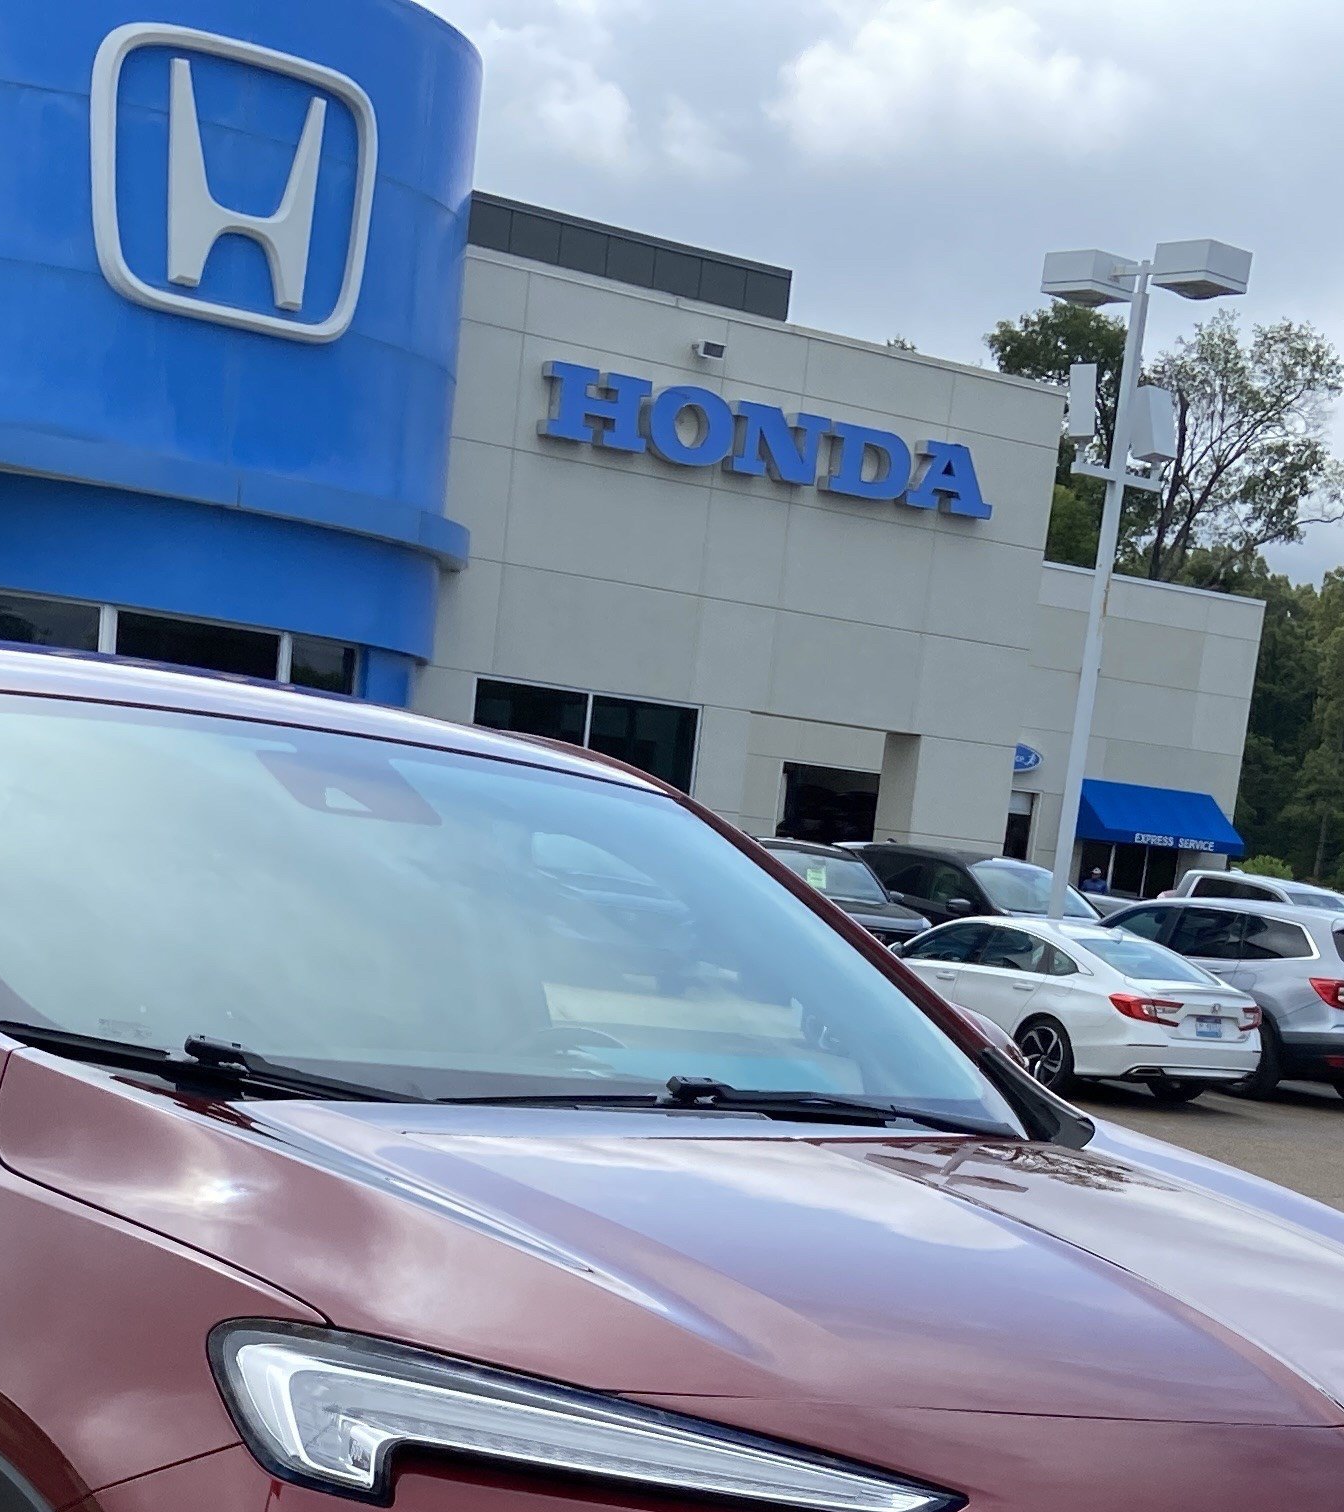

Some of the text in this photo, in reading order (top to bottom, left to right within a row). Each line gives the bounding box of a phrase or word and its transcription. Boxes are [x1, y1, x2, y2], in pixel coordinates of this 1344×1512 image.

[538, 359, 993, 520] HONDA
[1134, 832, 1215, 852] EXPRESS SERVICE
